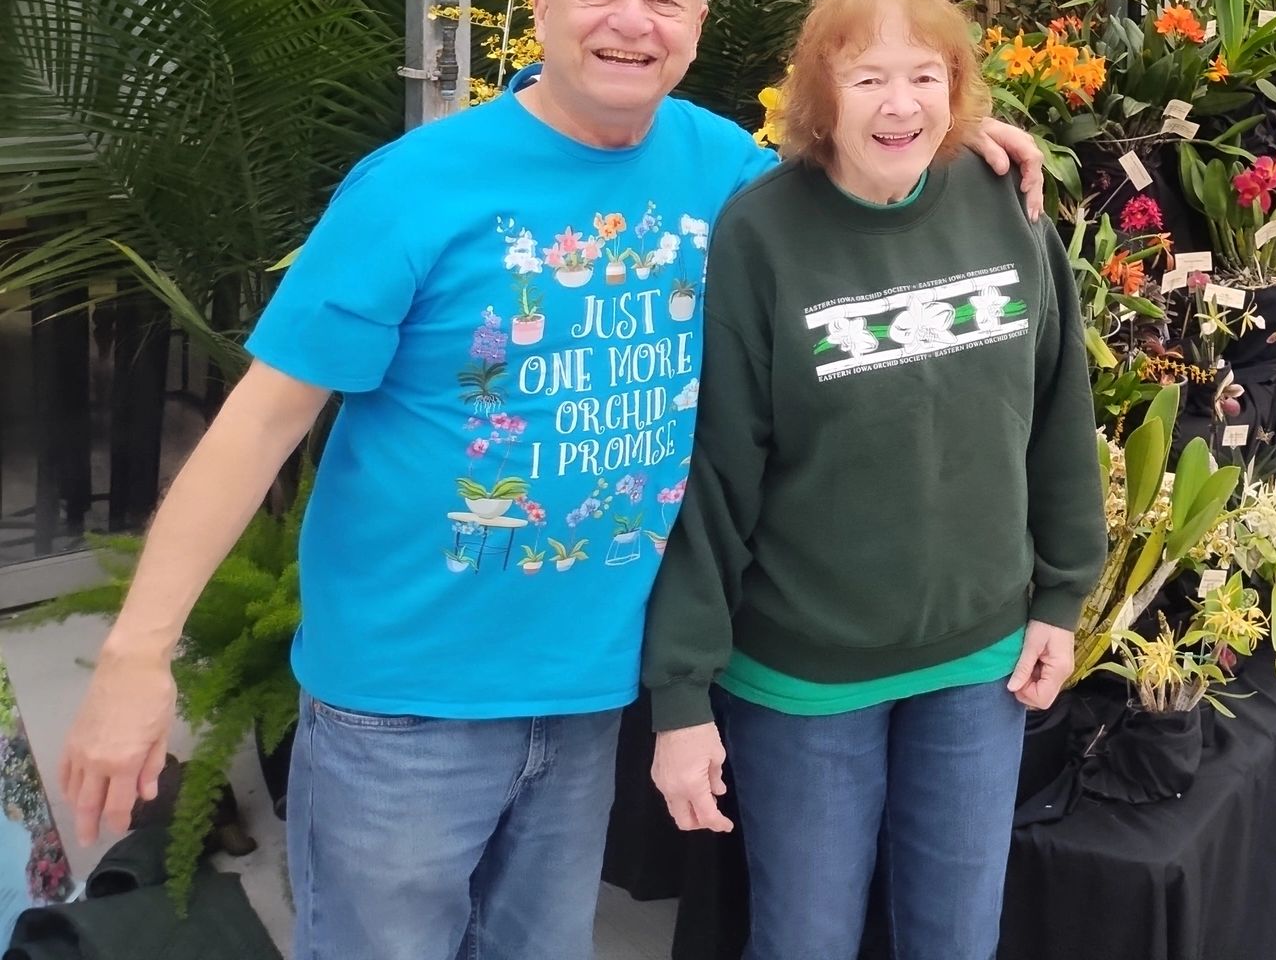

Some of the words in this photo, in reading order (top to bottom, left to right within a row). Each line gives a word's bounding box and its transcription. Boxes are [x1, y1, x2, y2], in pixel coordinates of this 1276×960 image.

[571, 289, 661, 339] JUST
[804, 298, 837, 314] EASTERN
[837, 296, 856, 304] IOWA
[855, 291, 882, 302] ORCHID
[883, 284, 911, 296] SOCIETY
[918, 277, 948, 289] EASTERN
[948, 273, 966, 282] IOWA
[966, 268, 989, 278] ORCHID
[989, 262, 1015, 273] SOCIETY
[518, 347, 593, 397] ONE
[608, 332, 693, 388] MORE
[818, 369, 852, 383] EASTERN
[853, 365, 873, 375] IOWA
[873, 360, 899, 371] ORCHID
[899, 353, 927, 365] SOCIETY
[934, 344, 966, 357] EASTERN
[966, 340, 984, 350] IOWA
[984, 335, 1008, 345] ORCHID
[1008, 328, 1029, 339] SOCIETY
[555, 385, 667, 435] ORCHID
[530, 442, 541, 479] I
[557, 420, 676, 477] PROMISE
